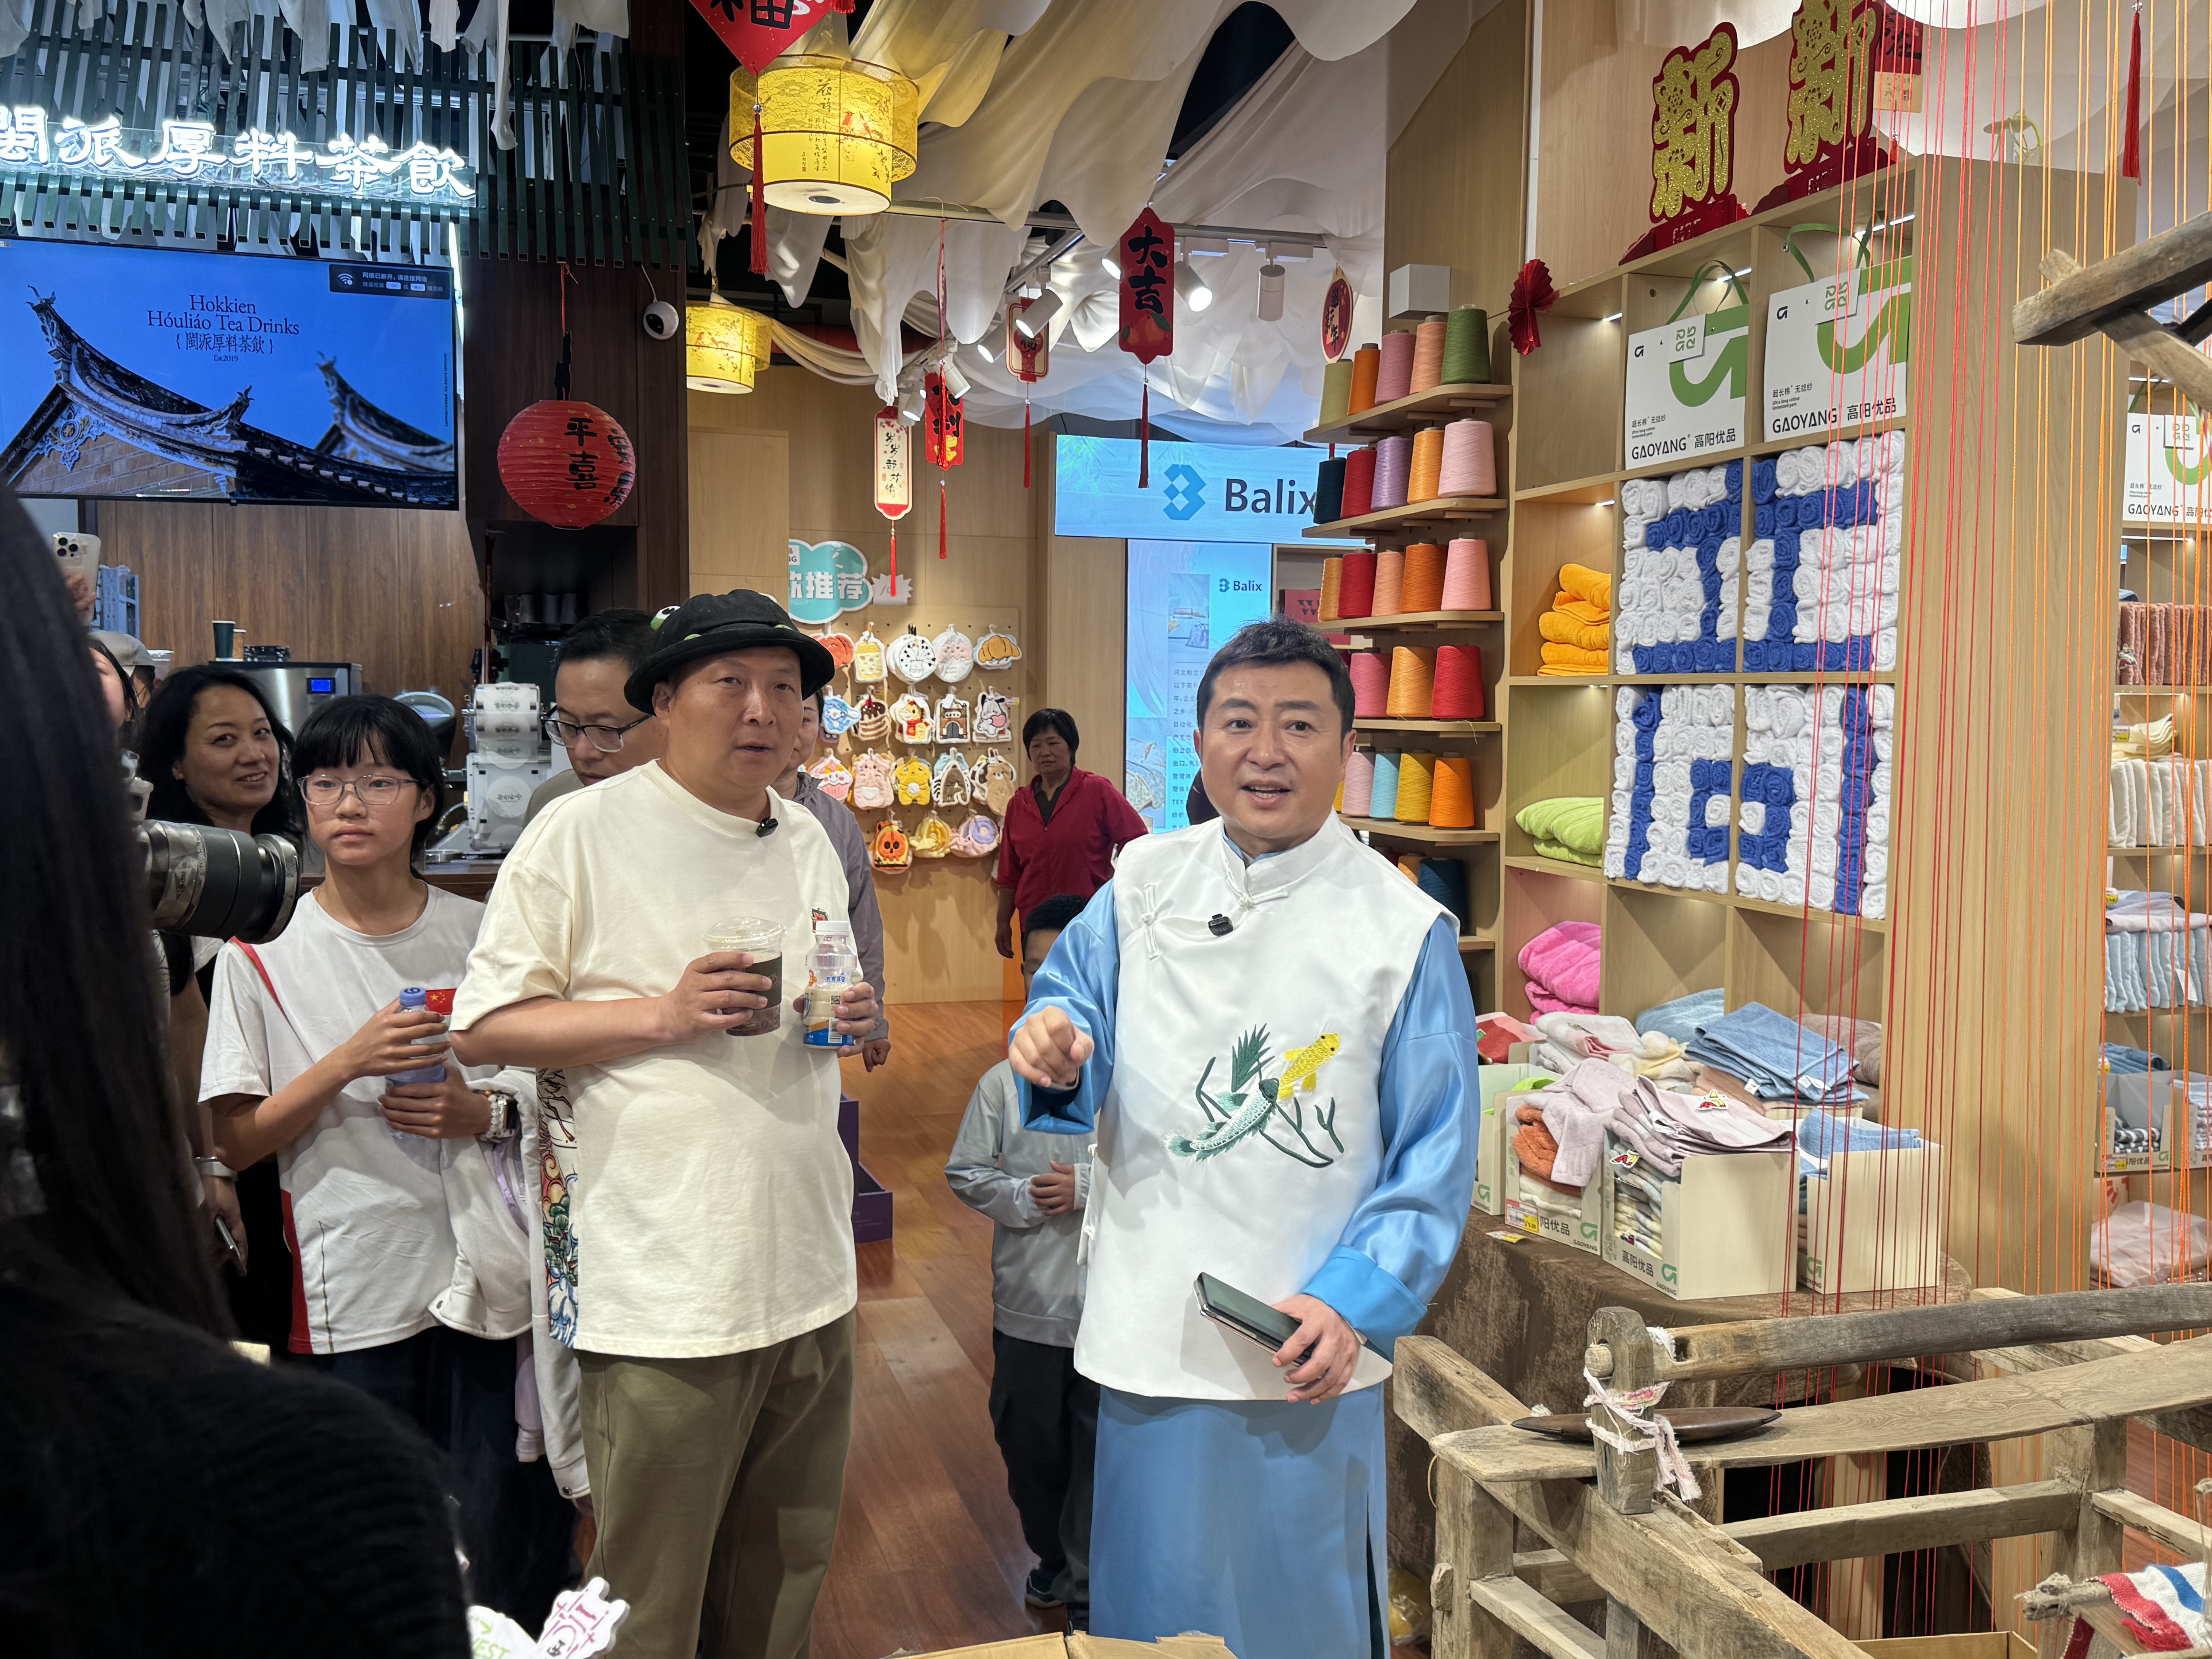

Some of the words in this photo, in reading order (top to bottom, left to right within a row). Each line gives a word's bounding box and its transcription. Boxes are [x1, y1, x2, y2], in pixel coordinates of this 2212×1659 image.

[1127, 225, 1168, 314] 大吉
[189, 294, 257, 314] Hokkien
[147, 310, 211, 330] Hóuliáo
[215, 313, 244, 331] Tea
[247, 316, 299, 335] Drinks
[185, 331, 265, 354] 閩派厚料茶飲
[1772, 408, 1838, 433] GAOYANG
[1847, 397, 1897, 421] 高阳优品
[1632, 437, 1686, 460] GAOYANG
[1694, 428, 1736, 448] 高阳优品
[1225, 478, 1317, 514] Balix
[2128, 503, 2179, 516] GAOYANG
[1233, 580, 1262, 591] Balix
[1540, 1216, 1570, 1236] 阳优品
[1573, 1239, 1598, 1251] GAOYANG
[1622, 1250, 1654, 1277] 高阳优品
